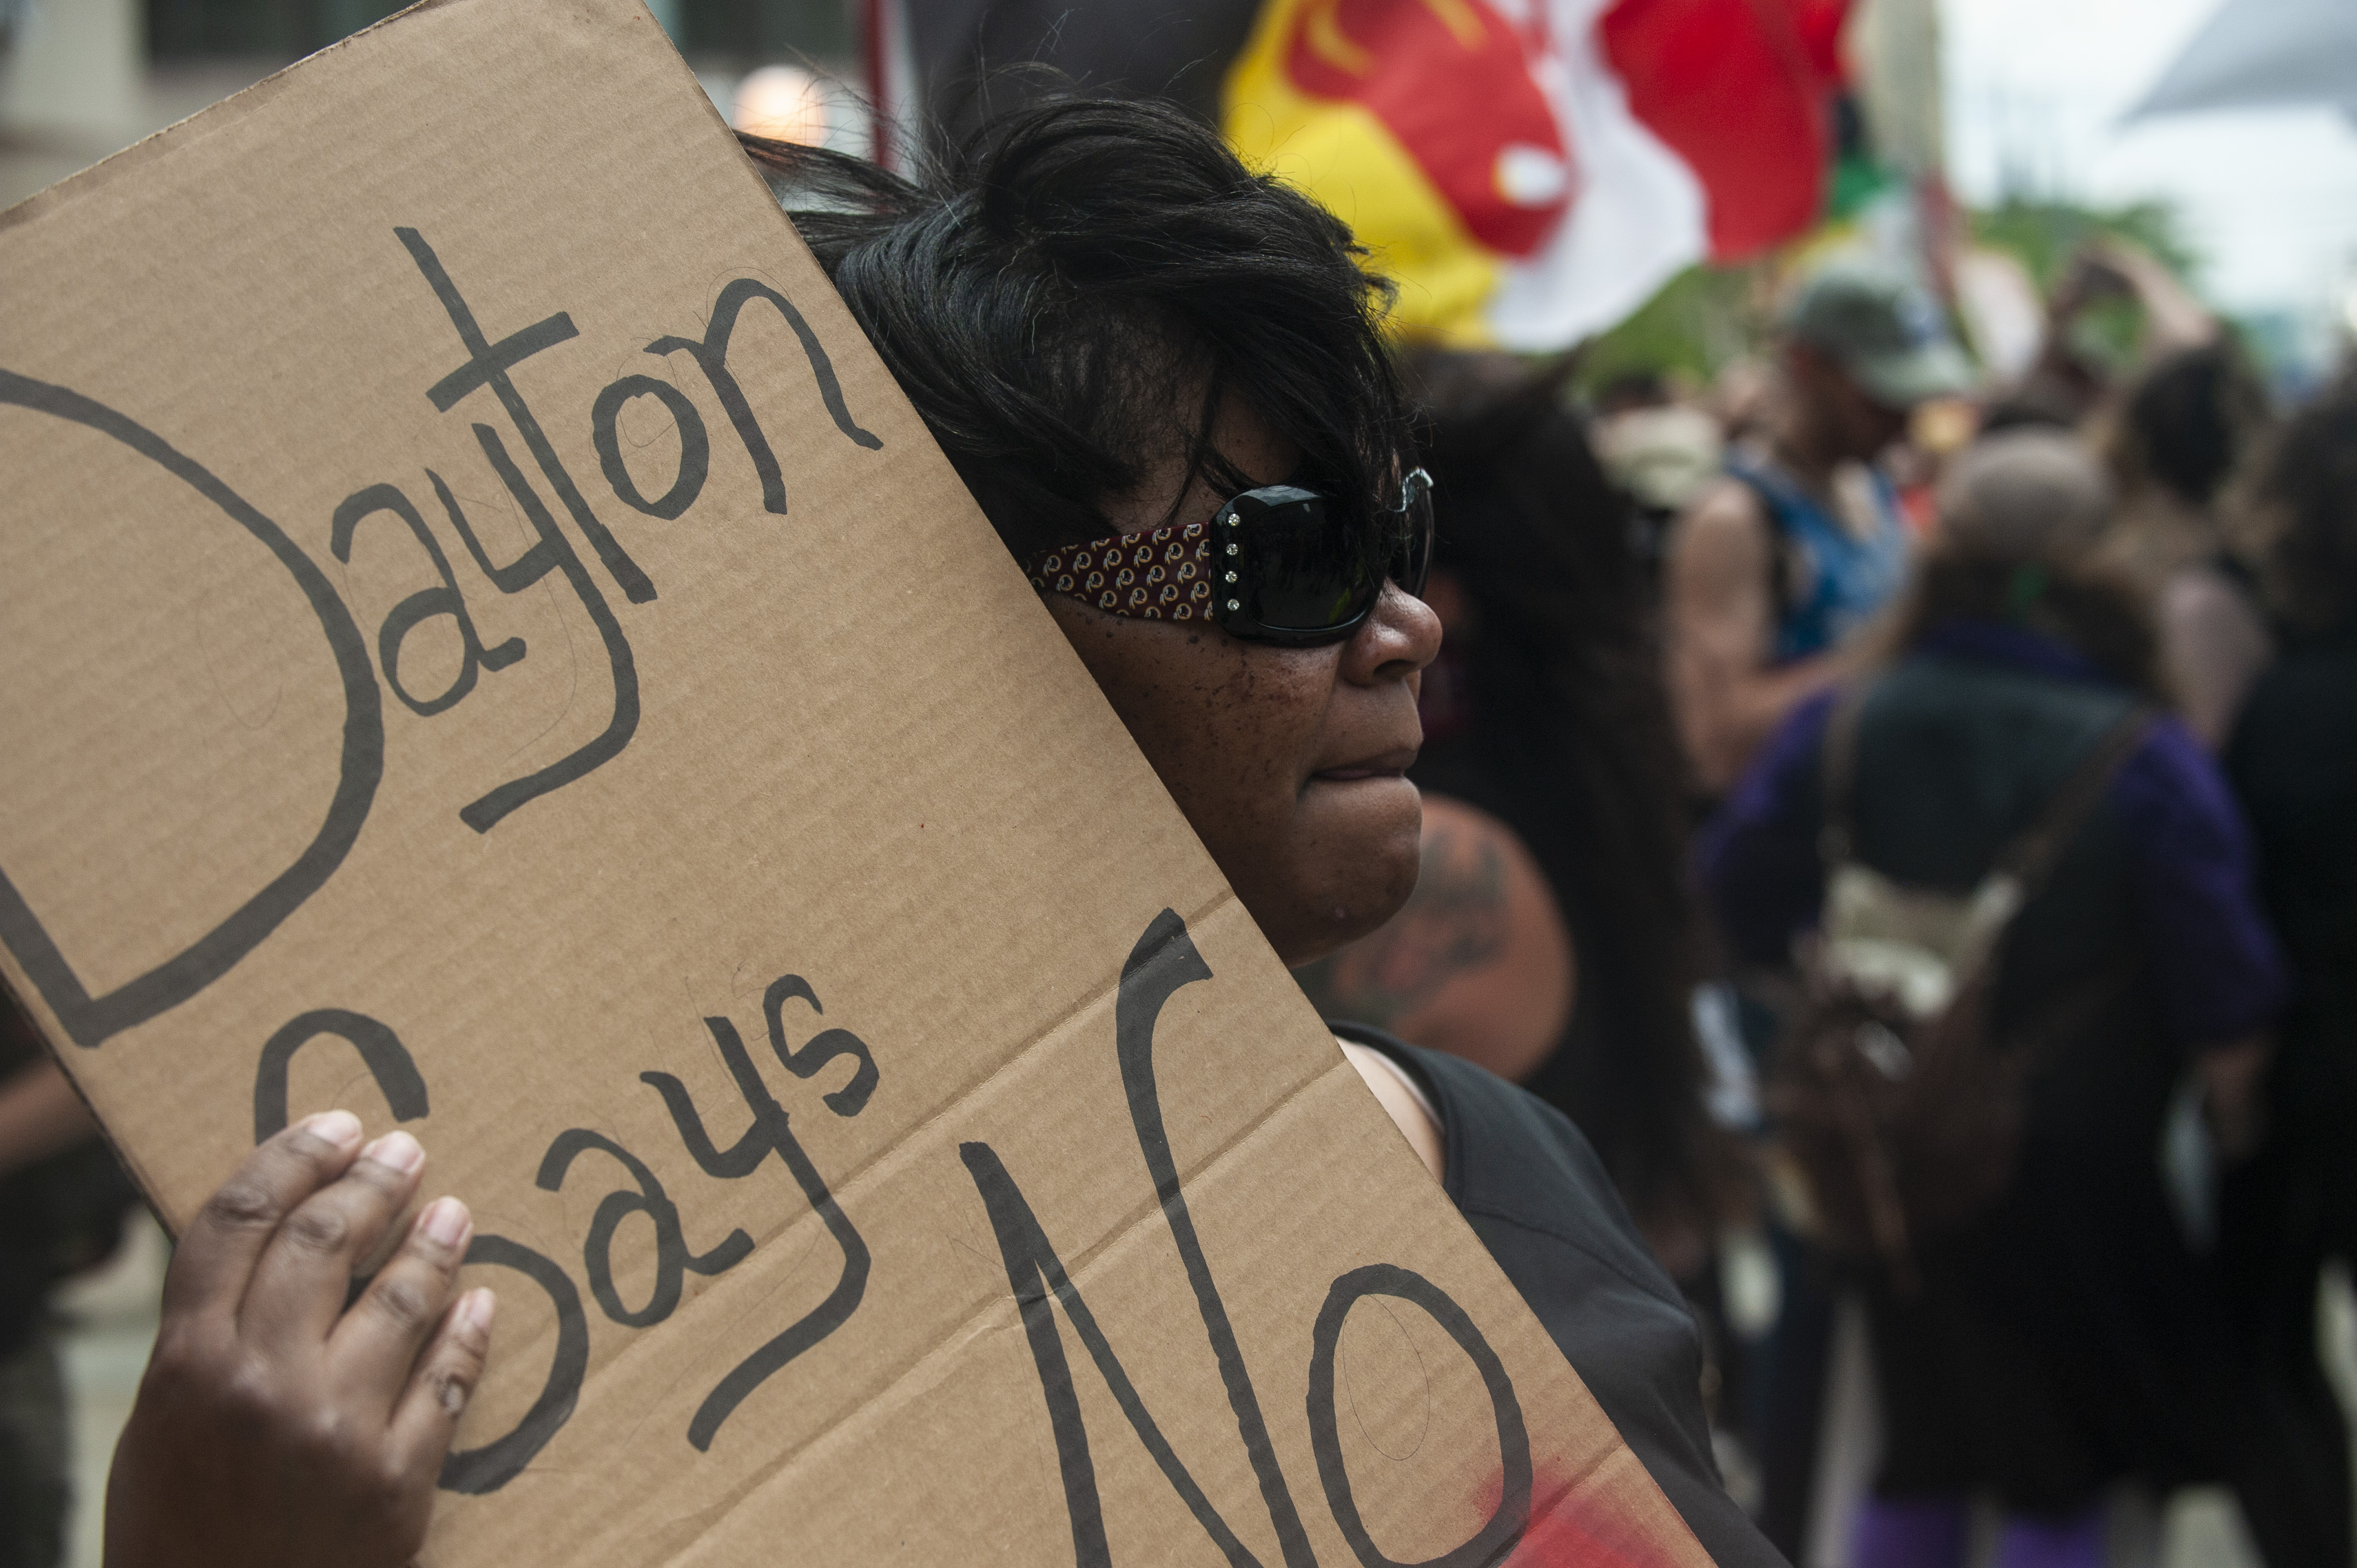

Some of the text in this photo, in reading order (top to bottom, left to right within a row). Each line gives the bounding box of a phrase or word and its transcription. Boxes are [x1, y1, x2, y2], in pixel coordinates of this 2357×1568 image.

[0, 226, 883, 1048] Dayton
[254, 974, 880, 1495] Says
[959, 907, 1533, 1568] No
